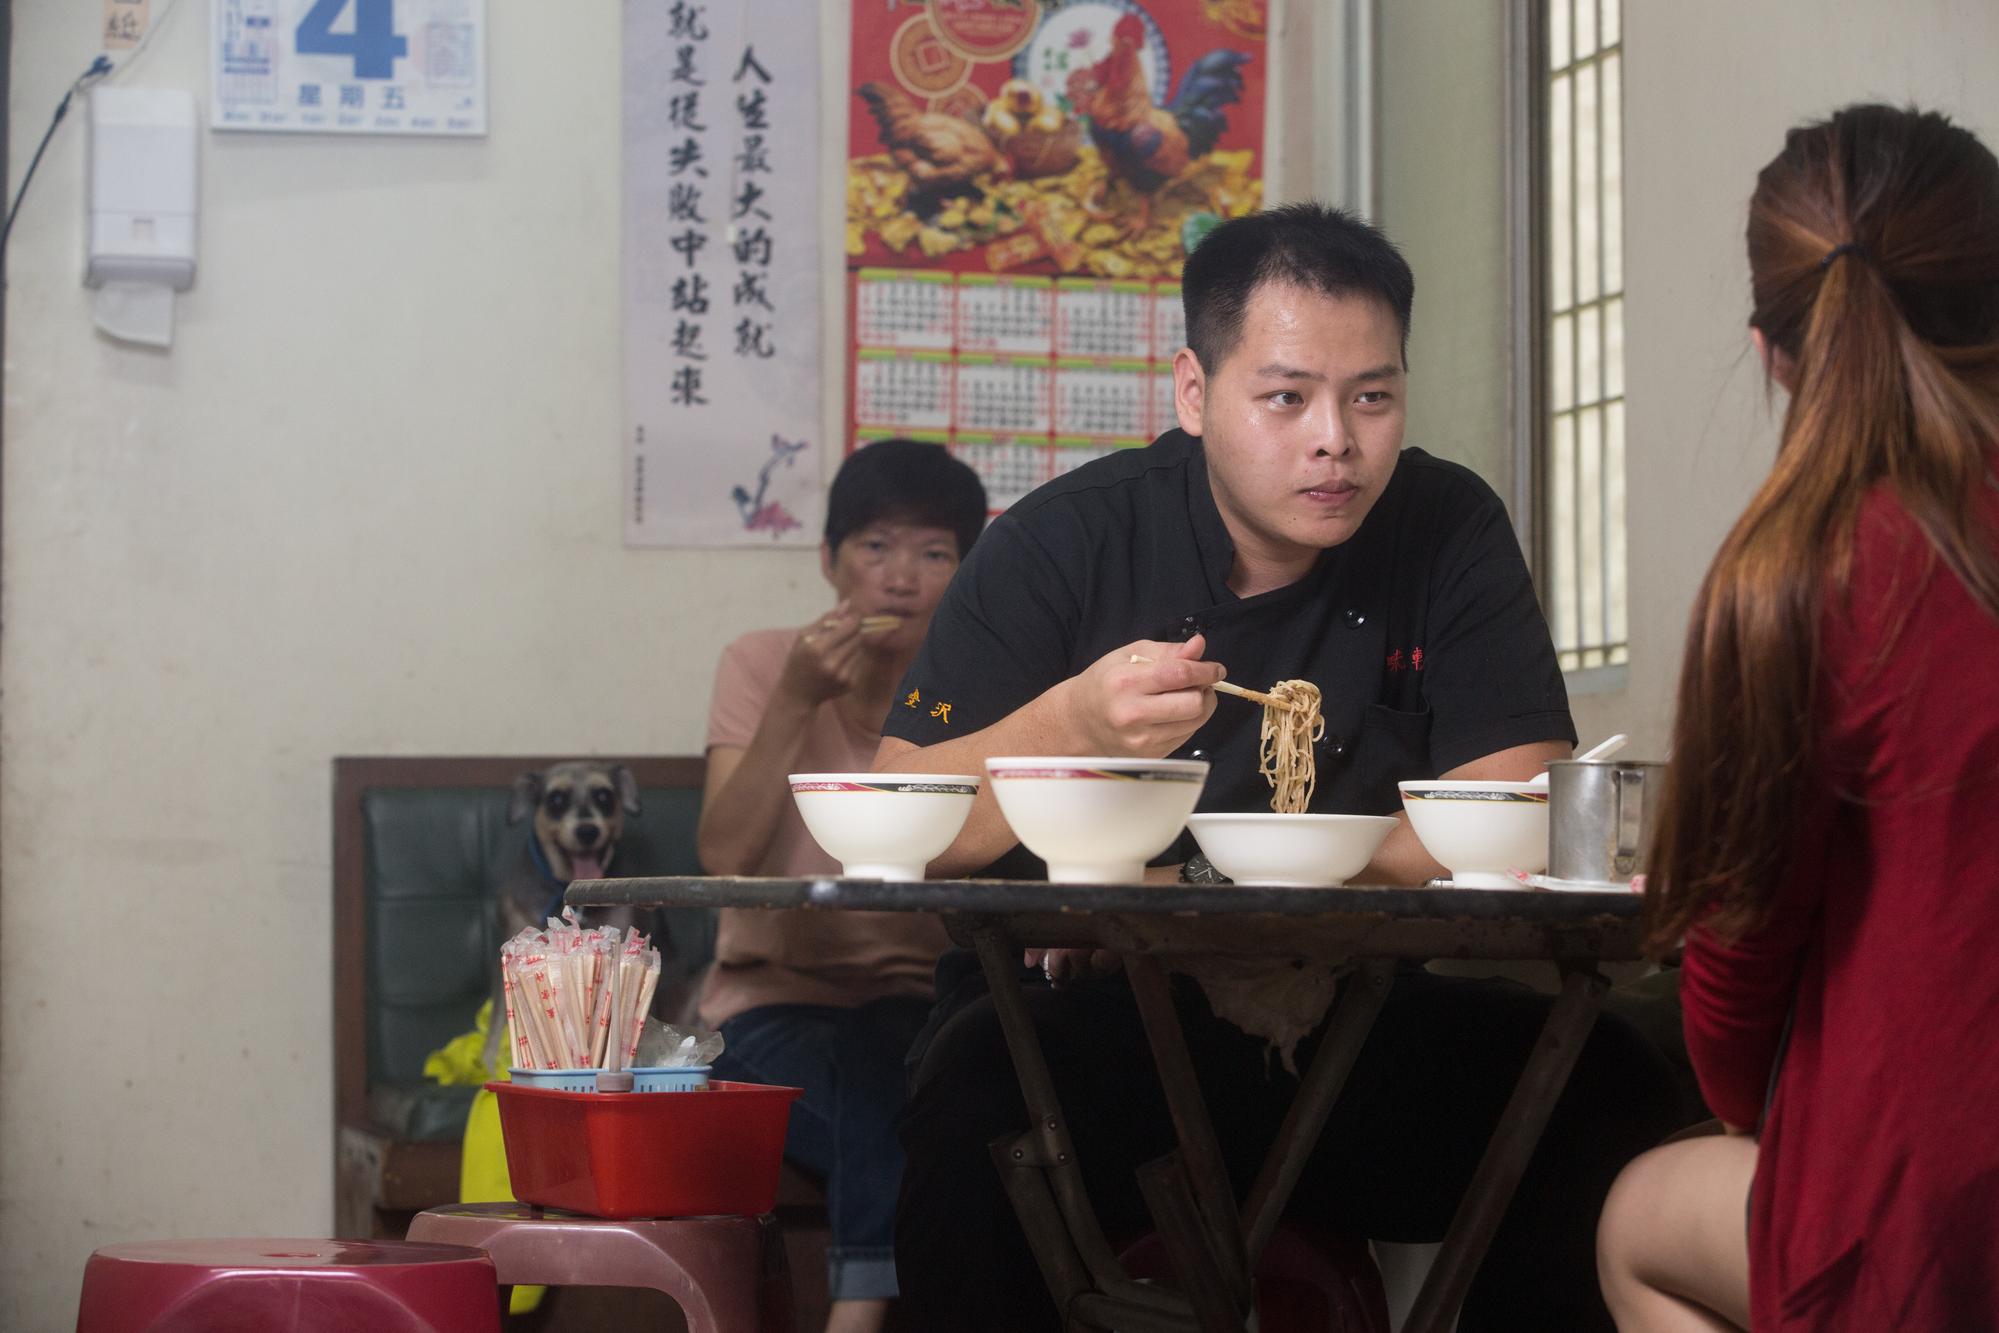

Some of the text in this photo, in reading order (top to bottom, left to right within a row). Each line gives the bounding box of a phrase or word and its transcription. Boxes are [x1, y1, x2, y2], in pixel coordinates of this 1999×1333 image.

[295, 0, 408, 80] 4
[298, 84, 405, 109] 星期五
[732, 44, 774, 359] 人生最大的成就
